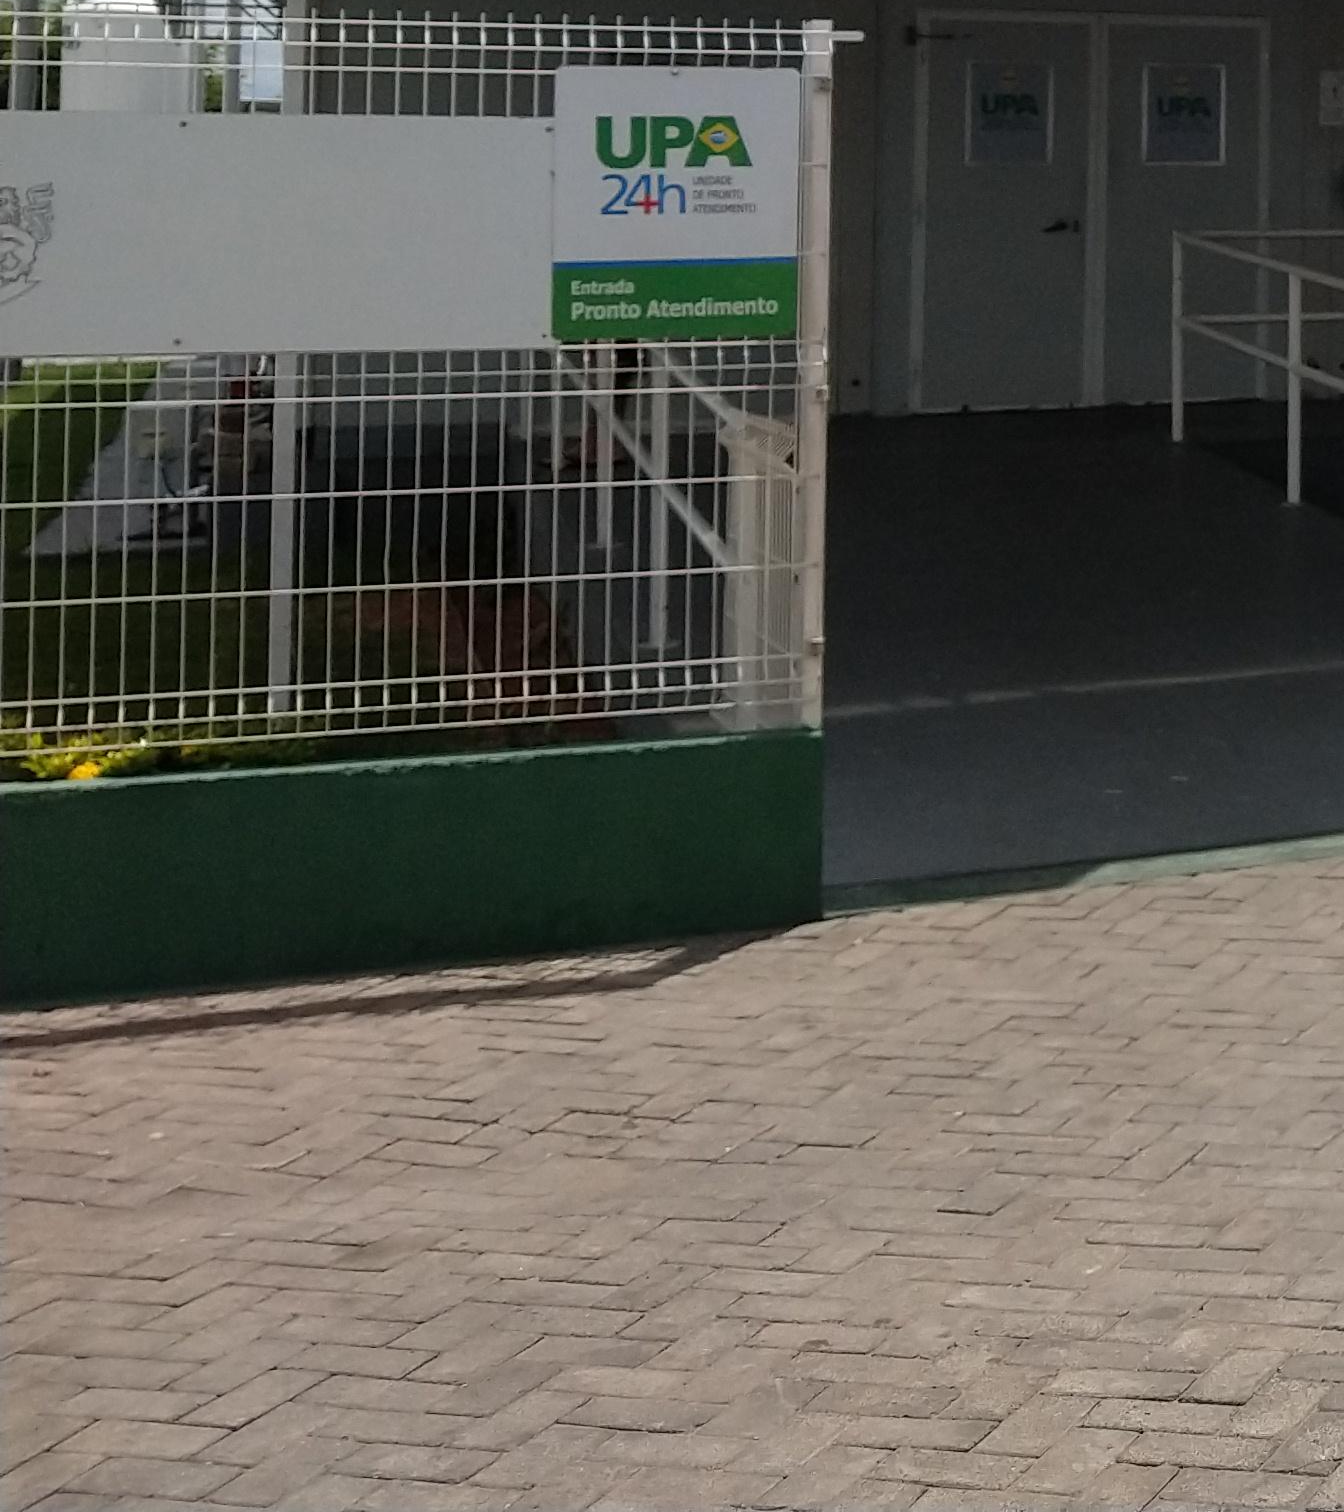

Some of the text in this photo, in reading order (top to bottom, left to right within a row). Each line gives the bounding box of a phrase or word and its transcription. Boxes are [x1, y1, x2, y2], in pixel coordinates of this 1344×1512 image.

[595, 115, 753, 169] UPA
[601, 173, 687, 215] 24h
[571, 279, 635, 296] Entrada
[571, 296, 779, 321] Pronto Atendimento
